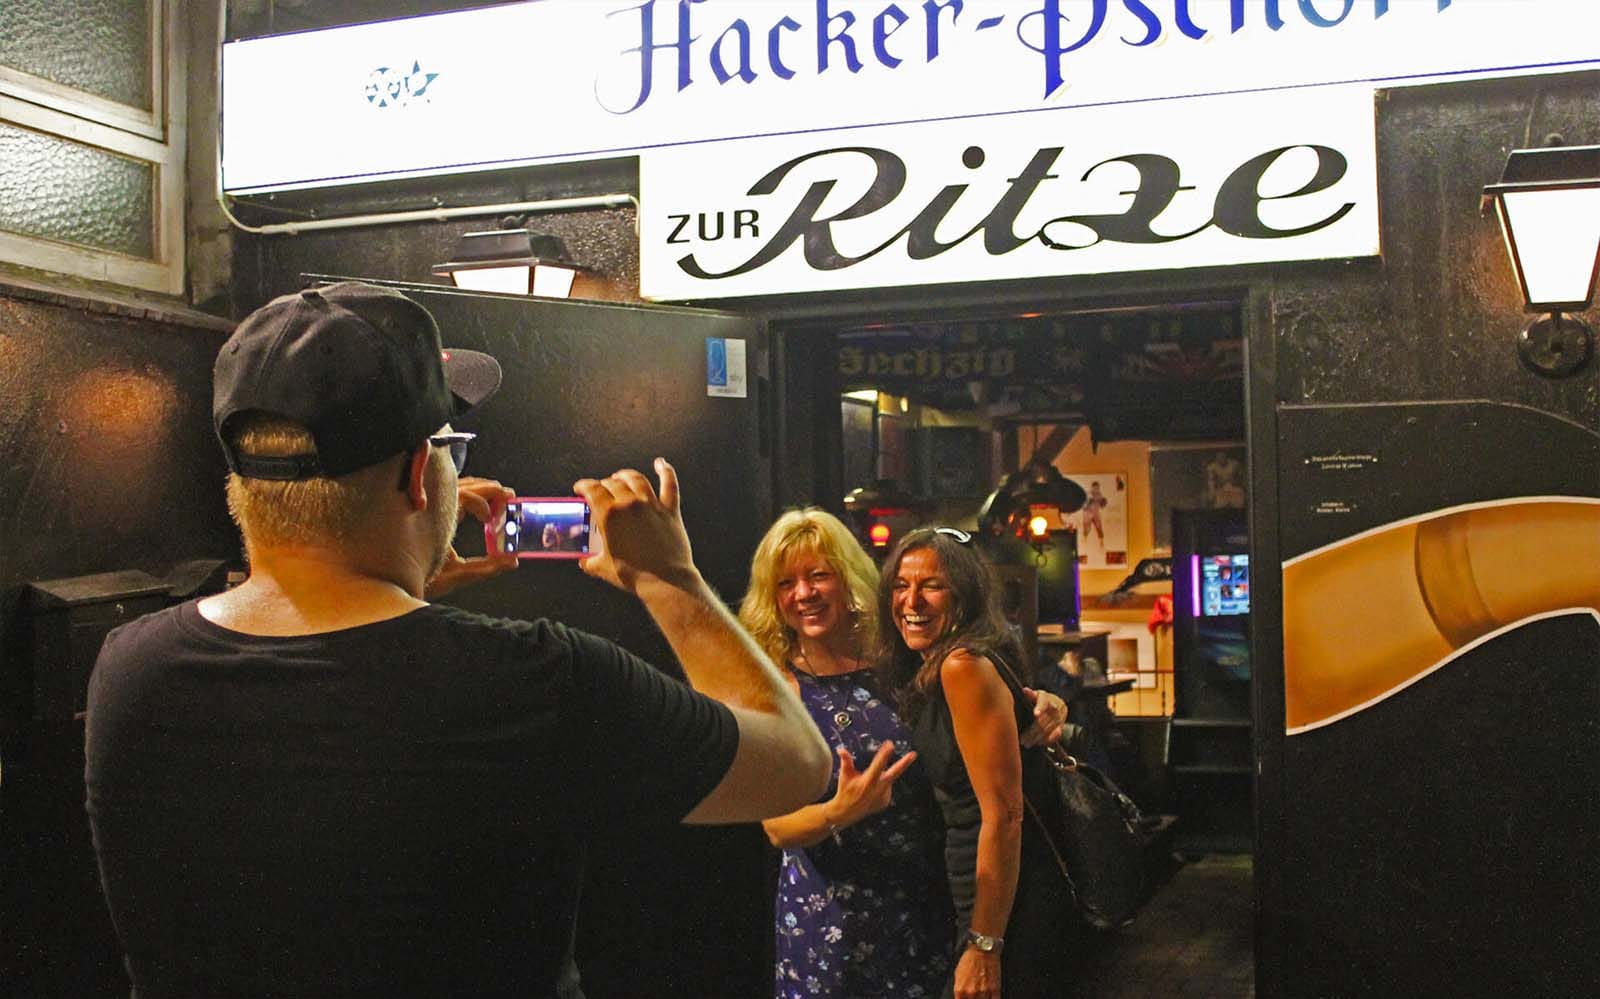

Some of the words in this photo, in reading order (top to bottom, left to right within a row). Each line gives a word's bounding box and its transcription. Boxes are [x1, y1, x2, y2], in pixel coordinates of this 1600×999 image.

[595, 0, 1451, 115] Hacker-Psc
[666, 210, 759, 245] ZUR
[677, 145, 1357, 280] Ritze
